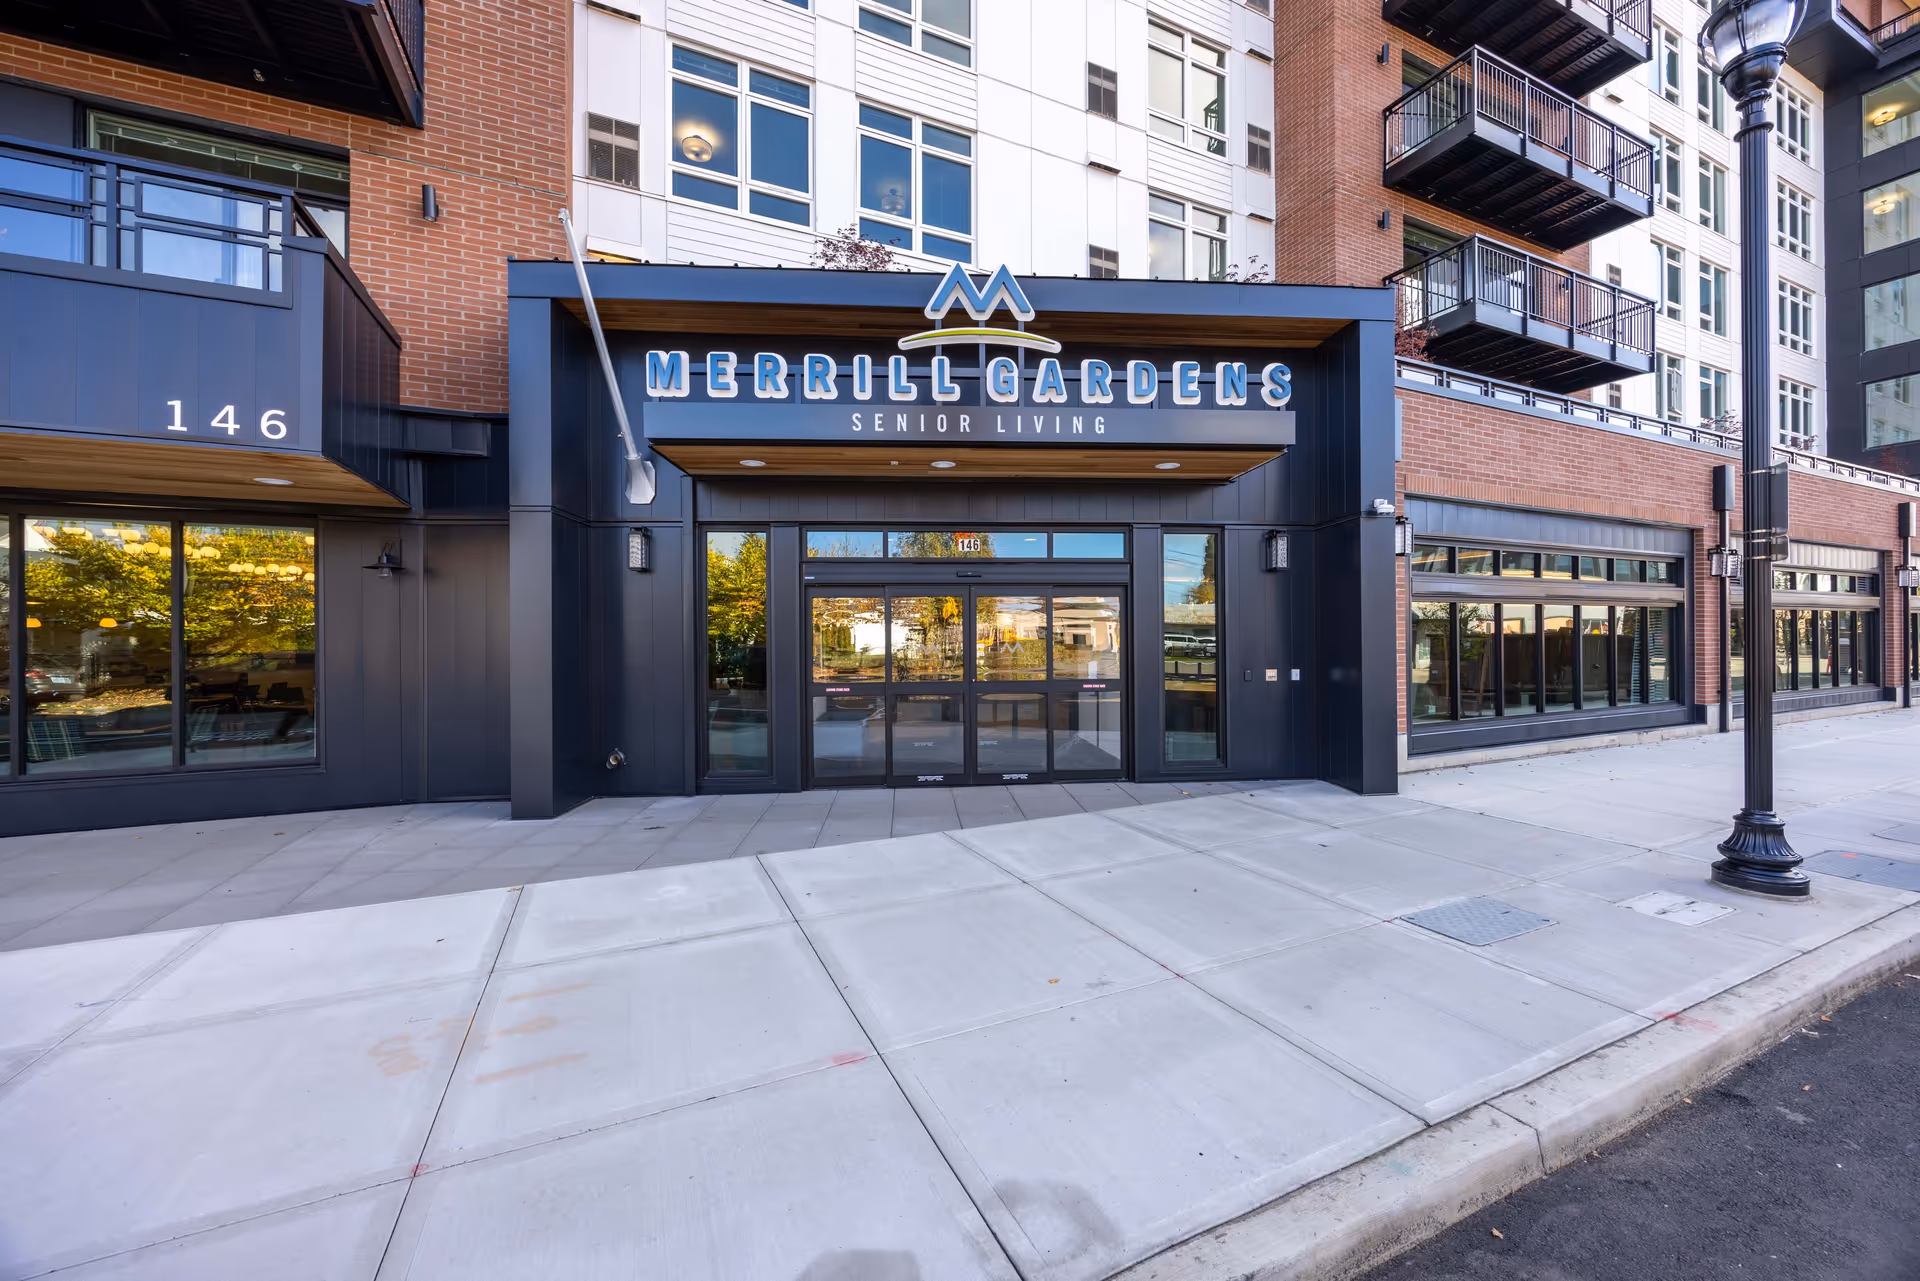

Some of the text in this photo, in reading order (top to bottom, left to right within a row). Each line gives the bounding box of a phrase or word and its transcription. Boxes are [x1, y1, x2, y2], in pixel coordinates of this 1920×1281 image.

[646, 351, 1293, 407] MERRILL GARDENS
[166, 399, 288, 440] 146
[851, 413, 1105, 434] SENIOR LIVING
[960, 539, 979, 551] 146
